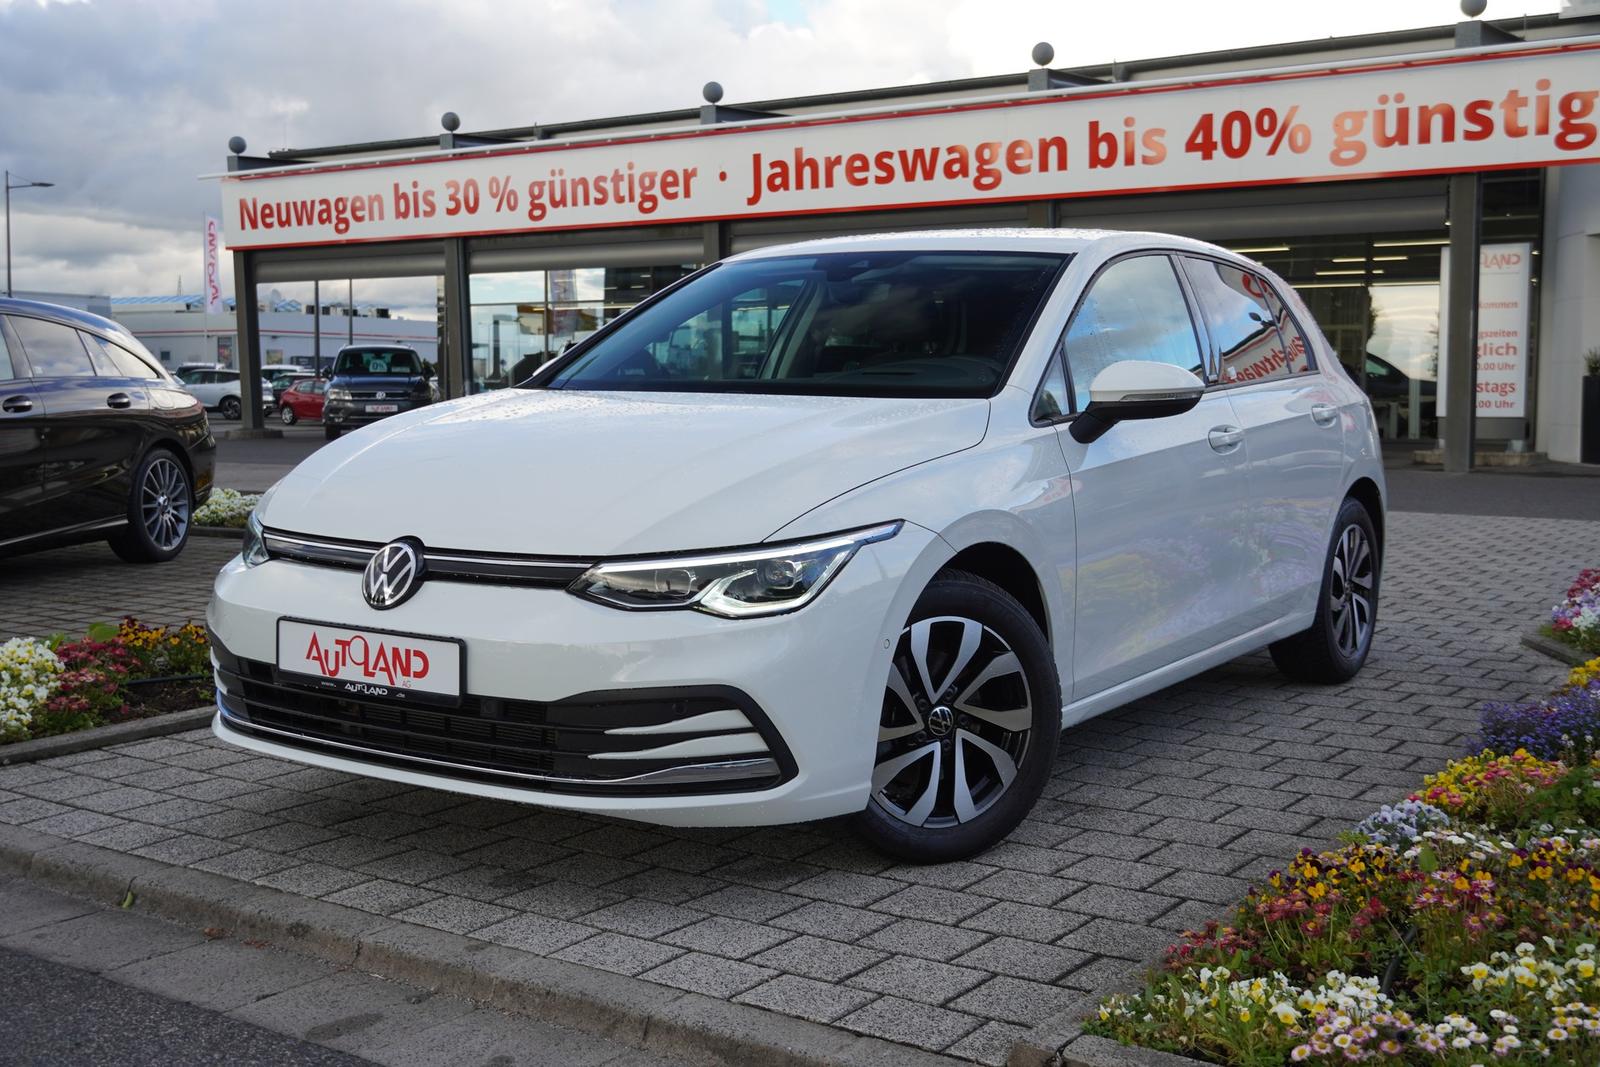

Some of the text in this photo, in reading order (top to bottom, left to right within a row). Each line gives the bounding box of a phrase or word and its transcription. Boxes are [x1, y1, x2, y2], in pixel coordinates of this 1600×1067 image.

[239, 193, 385, 235] Neuwagen
[393, 181, 437, 219] bis
[445, 178, 481, 216] 30
[489, 174, 519, 214] %
[527, 161, 699, 222] günstiger
[747, 135, 1069, 206] Jahreswagen
[1088, 116, 1168, 170] bis
[1184, 105, 1312, 161] 40%
[1497, 361, 1516, 371] Uhr
[1494, 399, 1515, 409] Uhr
[306, 632, 430, 686] AUTOLAND
[344, 682, 388, 696] AUTOLAND
